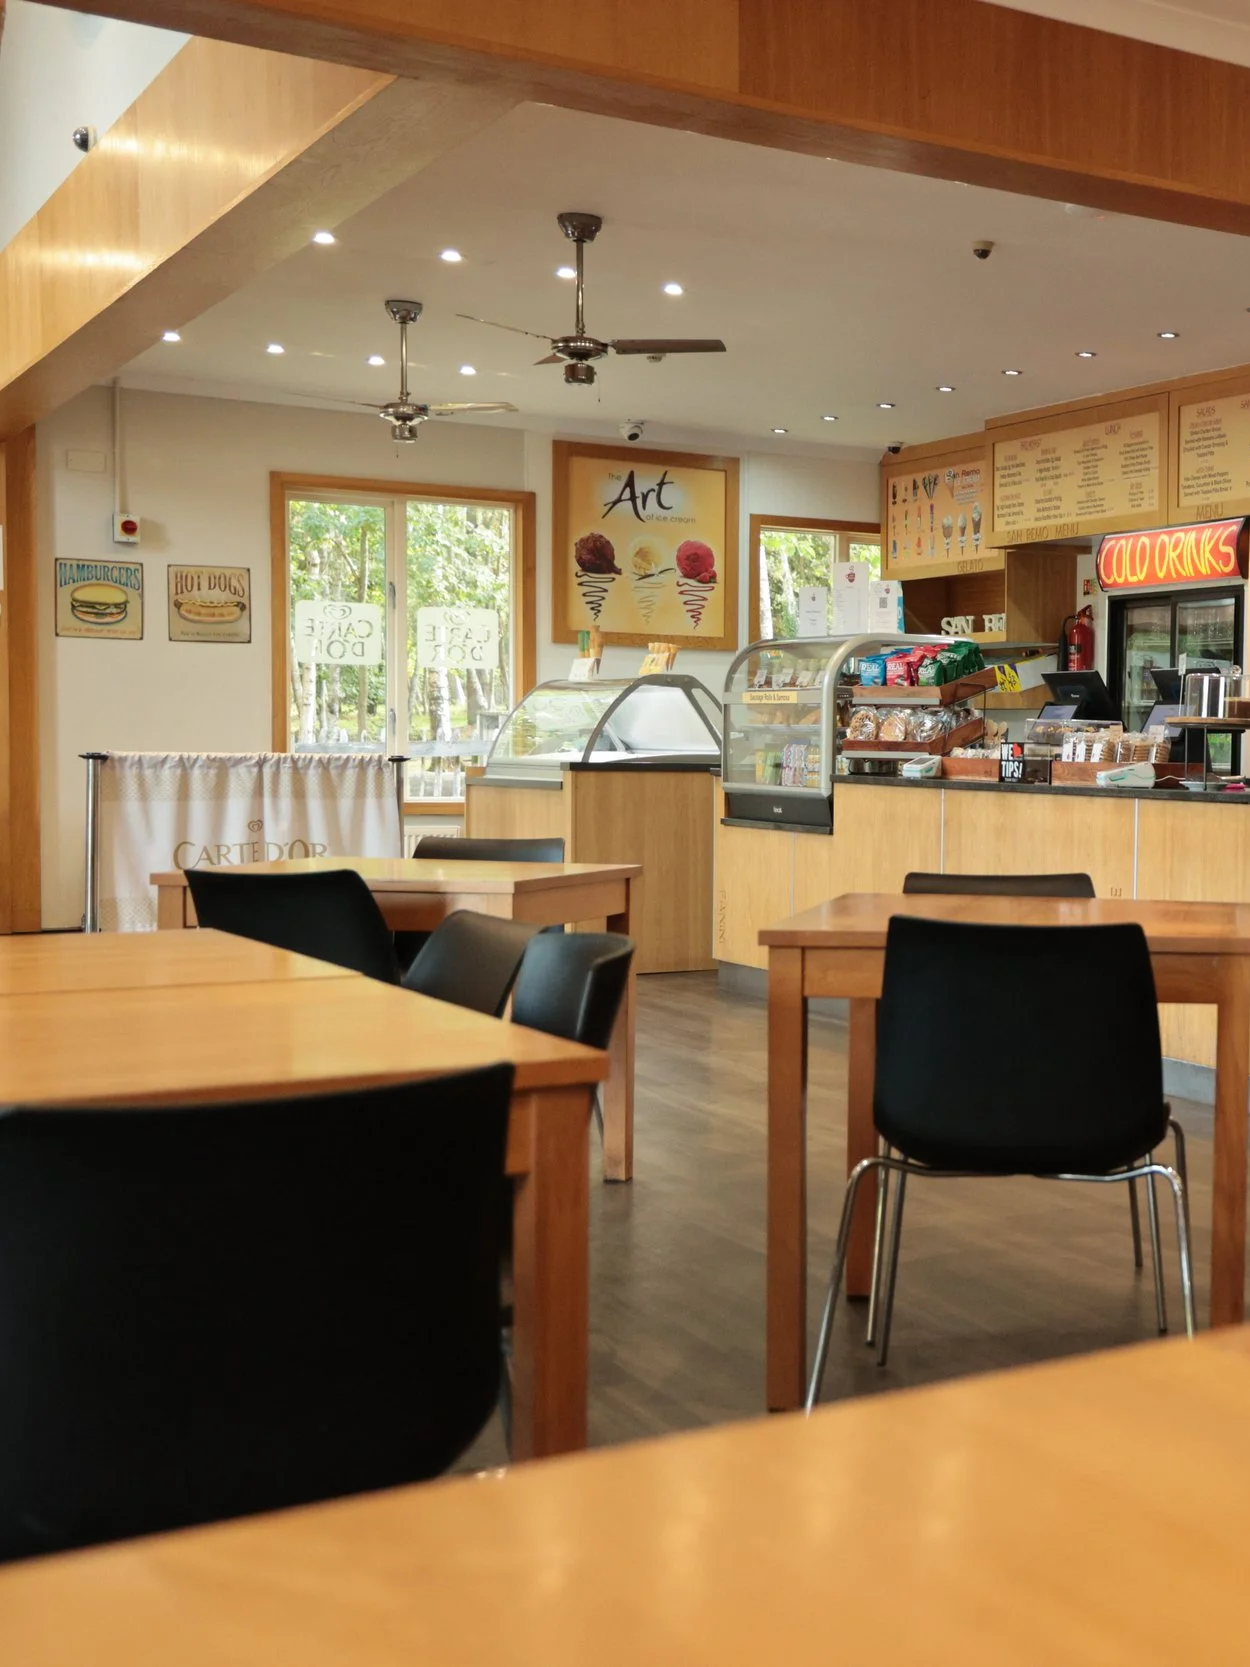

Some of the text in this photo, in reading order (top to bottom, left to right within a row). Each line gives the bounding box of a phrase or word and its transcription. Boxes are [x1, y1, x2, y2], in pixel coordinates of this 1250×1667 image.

[608, 473, 622, 481] The
[601, 470, 674, 523] Art
[1196, 502, 1224, 519] MENU
[1007, 522, 1079, 543] SAN REMO MENU
[1100, 525, 1237, 584] COLD DRINKS
[958, 559, 984, 573] GELATO
[59, 561, 141, 591] HAMBURGERS
[174, 570, 246, 598] HOT DOGS
[941, 616, 975, 635] SAN
[861, 661, 880, 672] REAL
[888, 661, 905, 671] REAL
[1001, 743, 1014, 760] WE
[1001, 761, 1023, 778] TIPS!
[173, 839, 328, 869] CARTE D'OR
